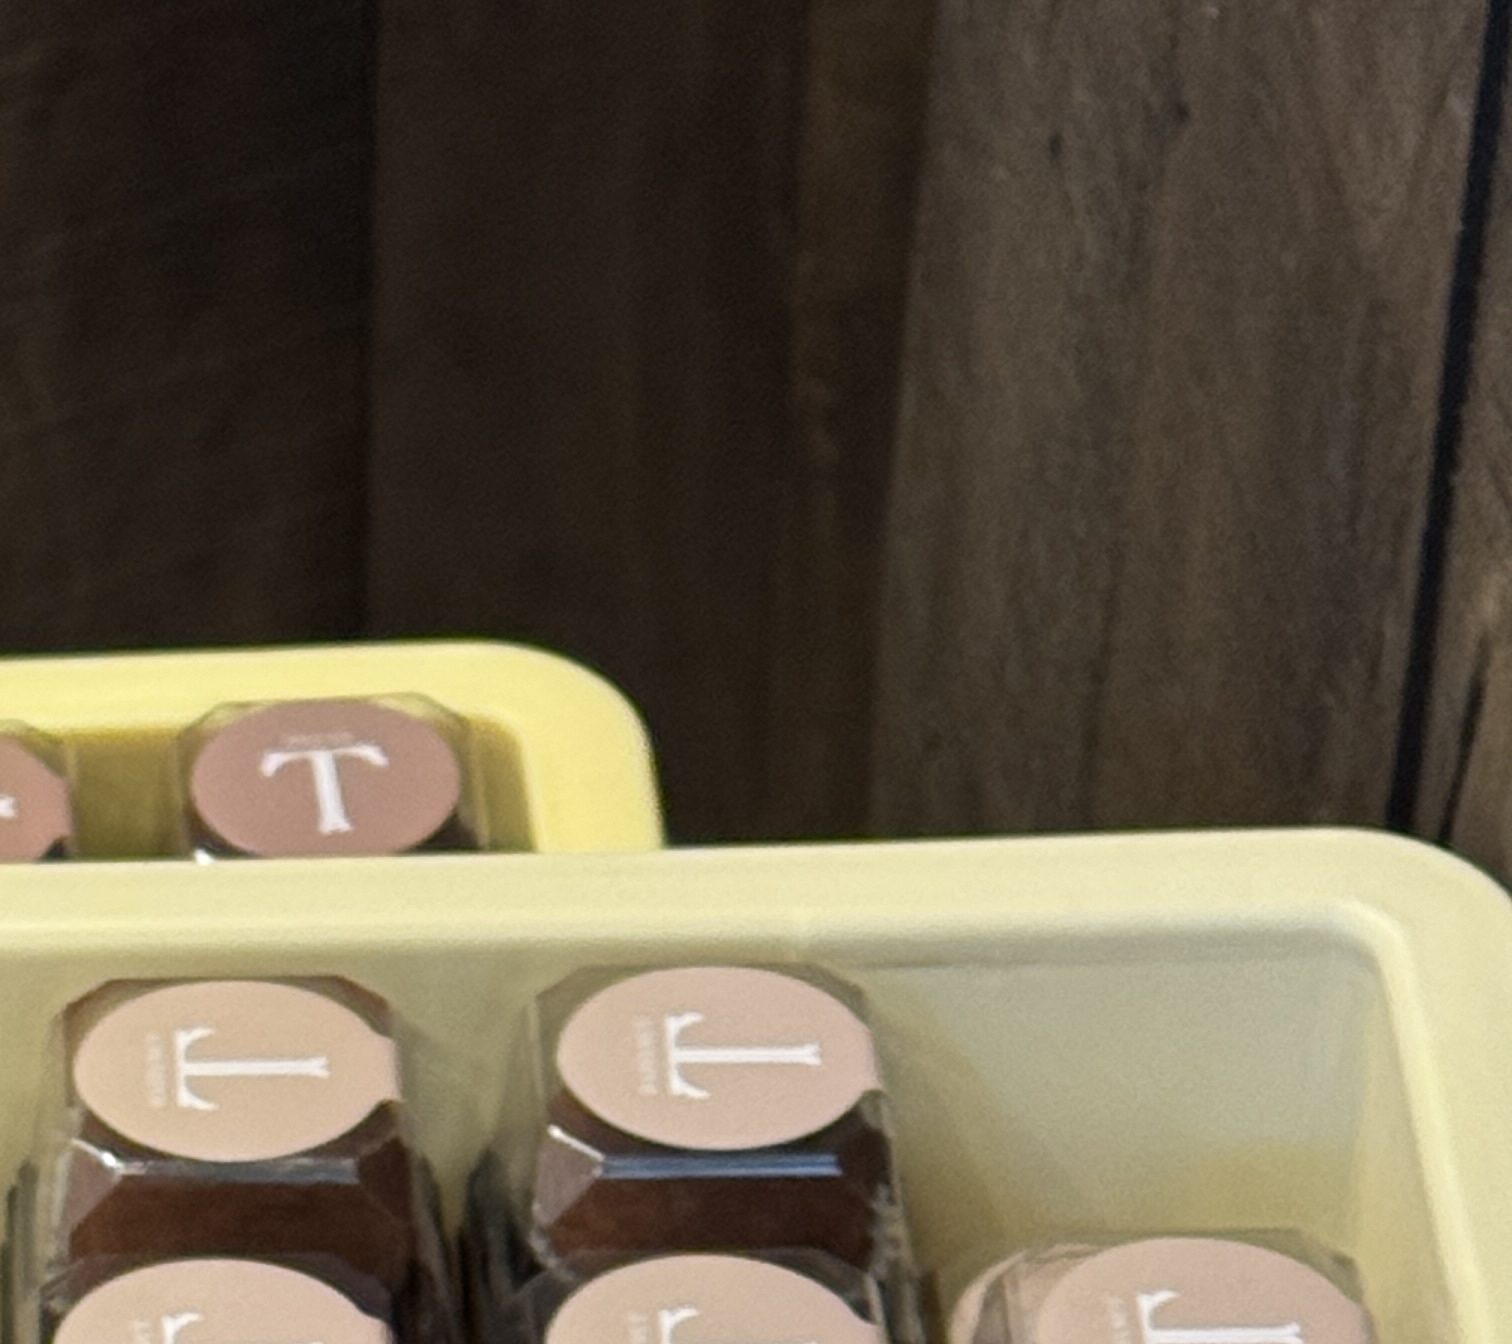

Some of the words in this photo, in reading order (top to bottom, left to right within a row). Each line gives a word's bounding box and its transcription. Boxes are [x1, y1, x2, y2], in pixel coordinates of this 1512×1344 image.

[261, 743, 388, 834] T
[174, 1027, 330, 1110] T
[666, 1012, 821, 1098] T
